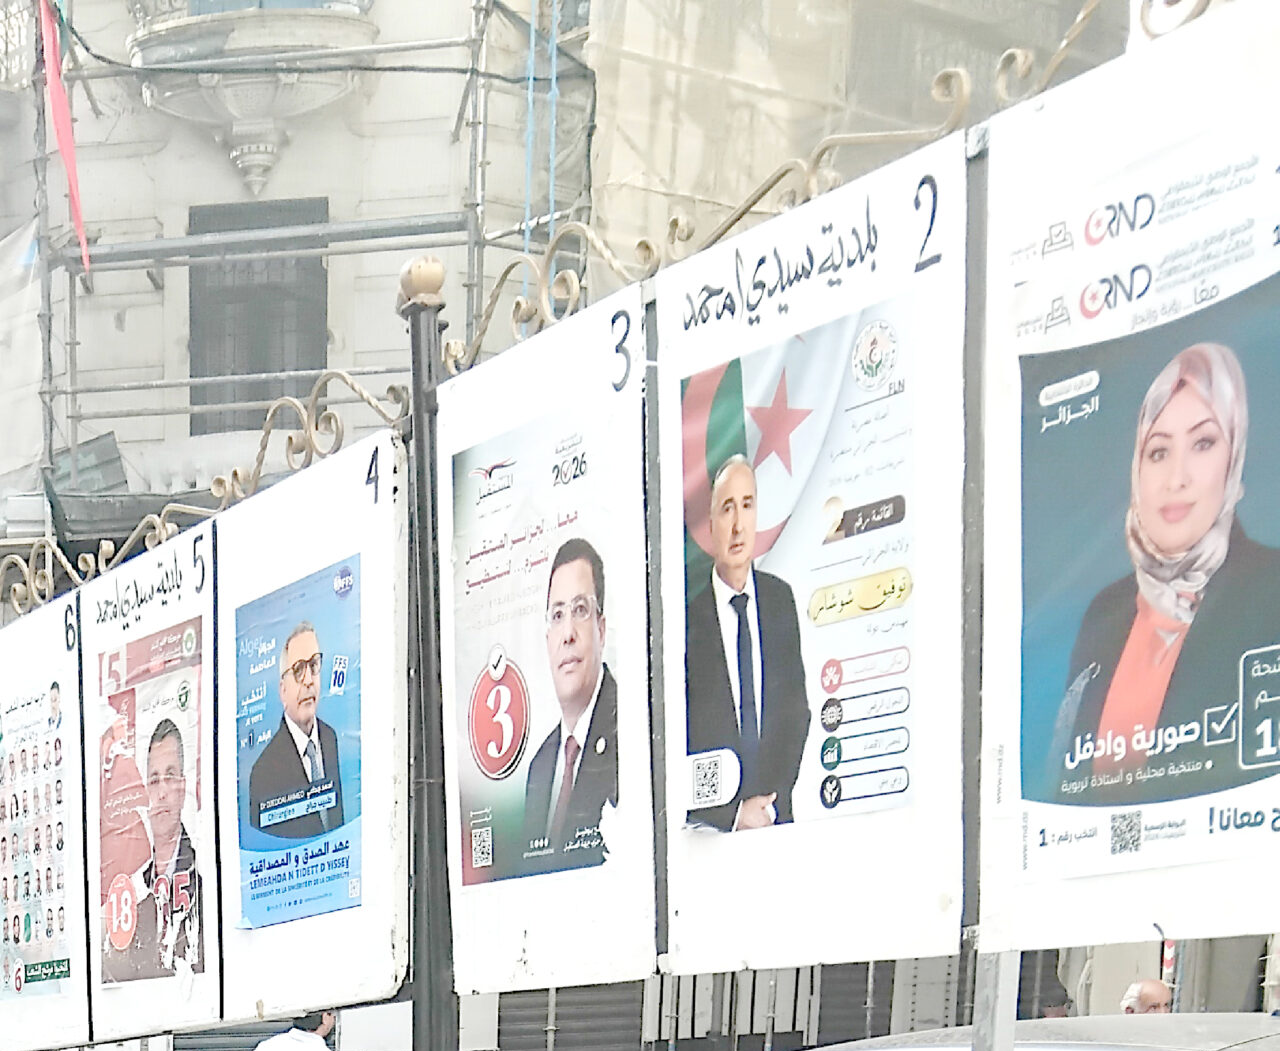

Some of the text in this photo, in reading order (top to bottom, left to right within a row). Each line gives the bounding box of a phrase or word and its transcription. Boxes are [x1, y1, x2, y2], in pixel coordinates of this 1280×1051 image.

[818, 194, 878, 288] بلدية
[914, 174, 942, 273] 2
[746, 244, 815, 327] سيدي
[611, 309, 631, 392] 3
[888, 378, 905, 395] FLN
[1040, 395, 1100, 433] الجزائر
[365, 446, 379, 504] 4
[821, 495, 845, 546] 2
[193, 534, 205, 594] 5
[65, 604, 76, 651] 6
[333, 670, 345, 688] 10
[335, 656, 347, 669] FFS
[486, 685, 514, 760] 3
[1131, 719, 1201, 756] صورية
[249, 851, 292, 878] المصداقية
[302, 841, 330, 865] الصدق
[109, 890, 132, 933] 18
[14, 967, 23, 992] 6
